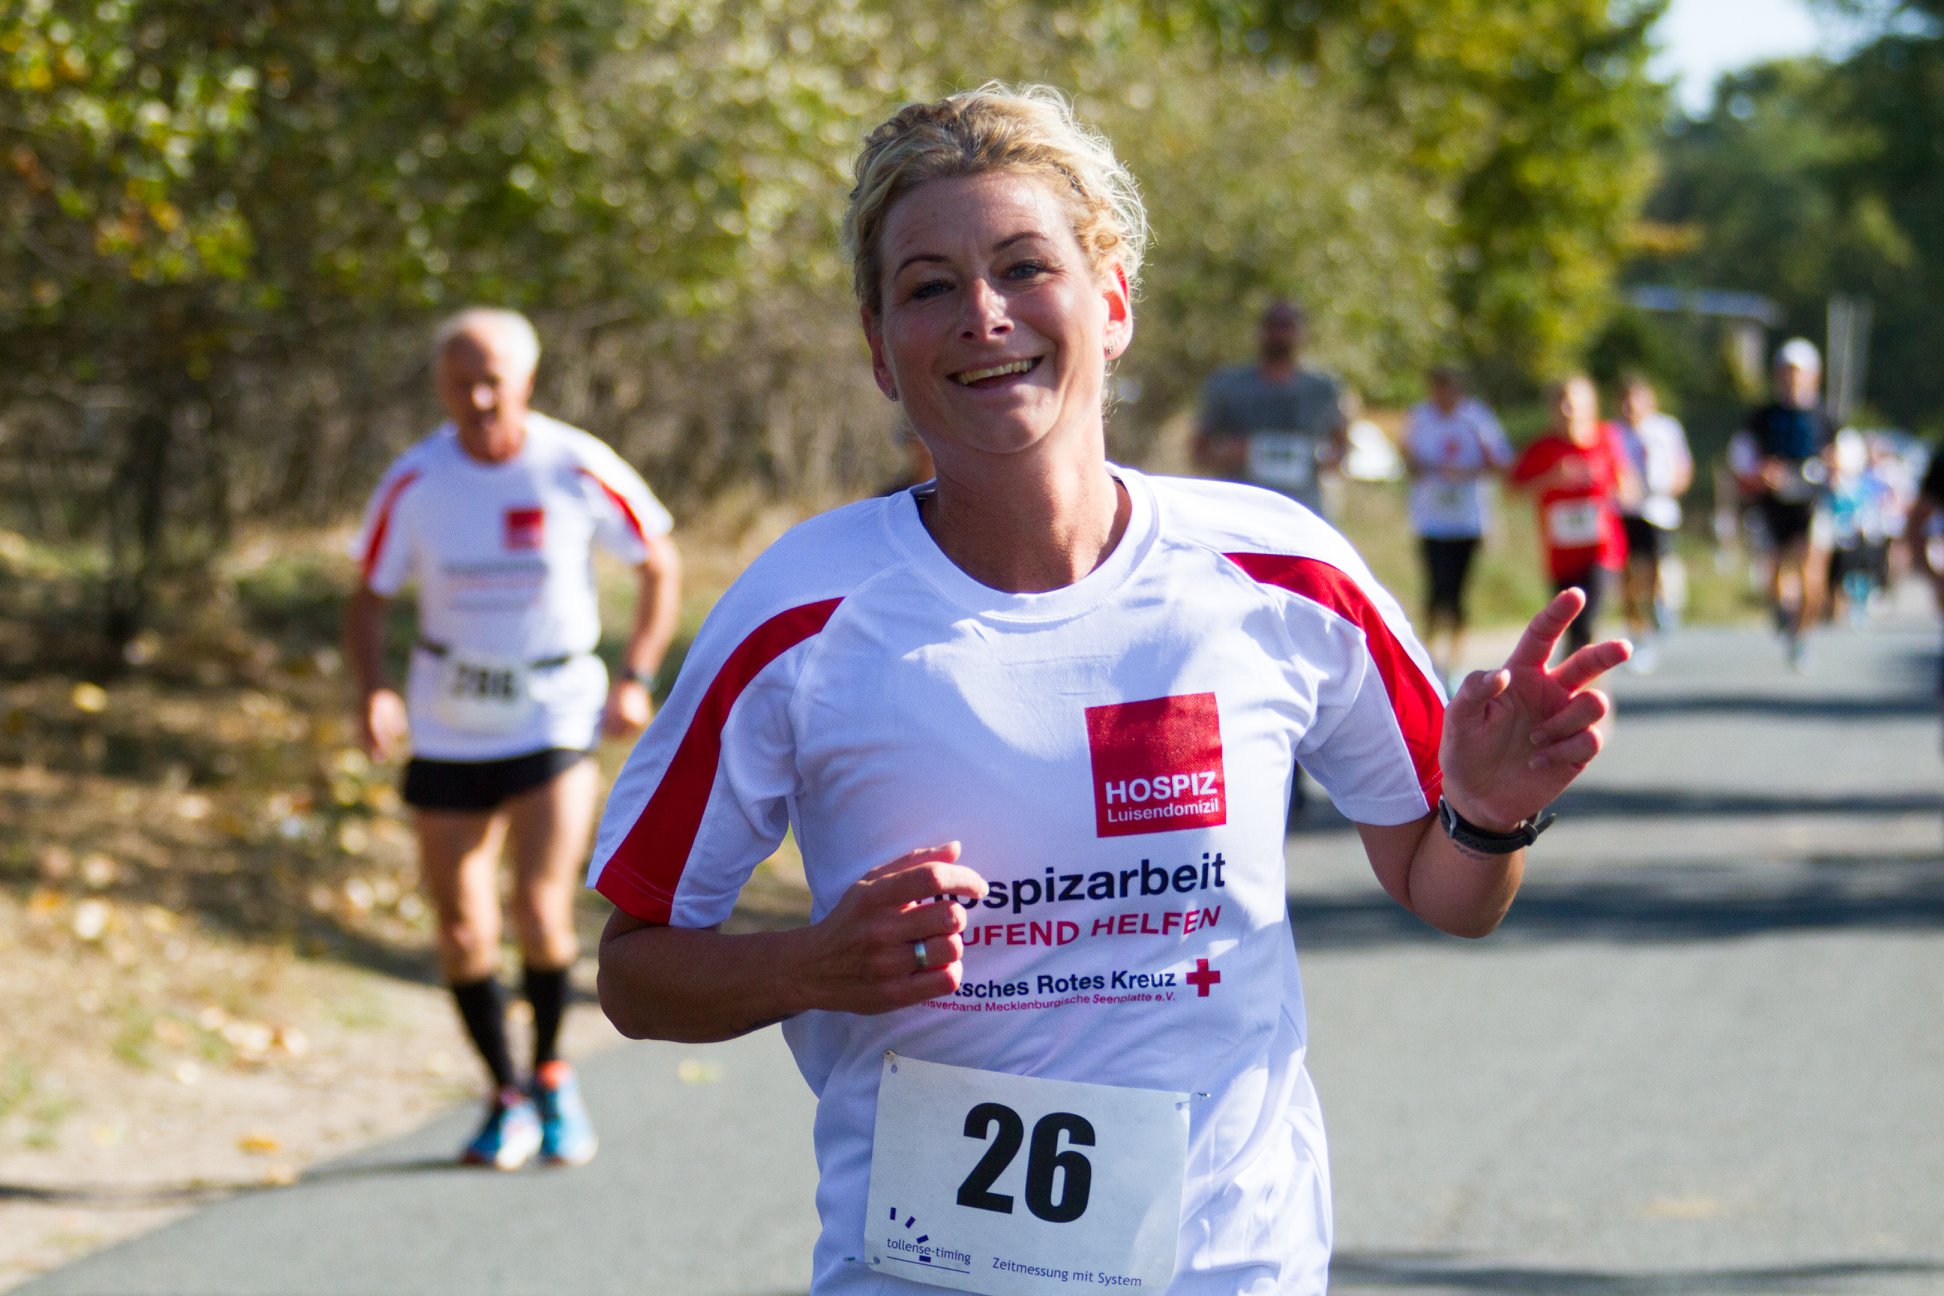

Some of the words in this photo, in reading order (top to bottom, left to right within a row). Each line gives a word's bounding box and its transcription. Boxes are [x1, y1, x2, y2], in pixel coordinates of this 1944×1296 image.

[1105, 771, 1218, 804] HOSPIZ
[1107, 798, 1219, 822] Luisendomizil
[962, 920, 1079, 947] UFEND
[1091, 905, 1221, 936] HELFEN
[1037, 974, 1105, 994] Rotes
[1111, 970, 1176, 989] Kreuz
[985, 994, 1089, 1012] Mecklenburgische
[1092, 992, 1152, 1004] Seenplatte
[1155, 991, 1176, 1001] e.V.
[956, 1102, 1096, 1223] 26
[887, 1238, 971, 1265] tollense-timing
[992, 1257, 1068, 1282] Zeitmessung
[1072, 1271, 1094, 1282] mit
[1097, 1272, 1142, 1288] System
